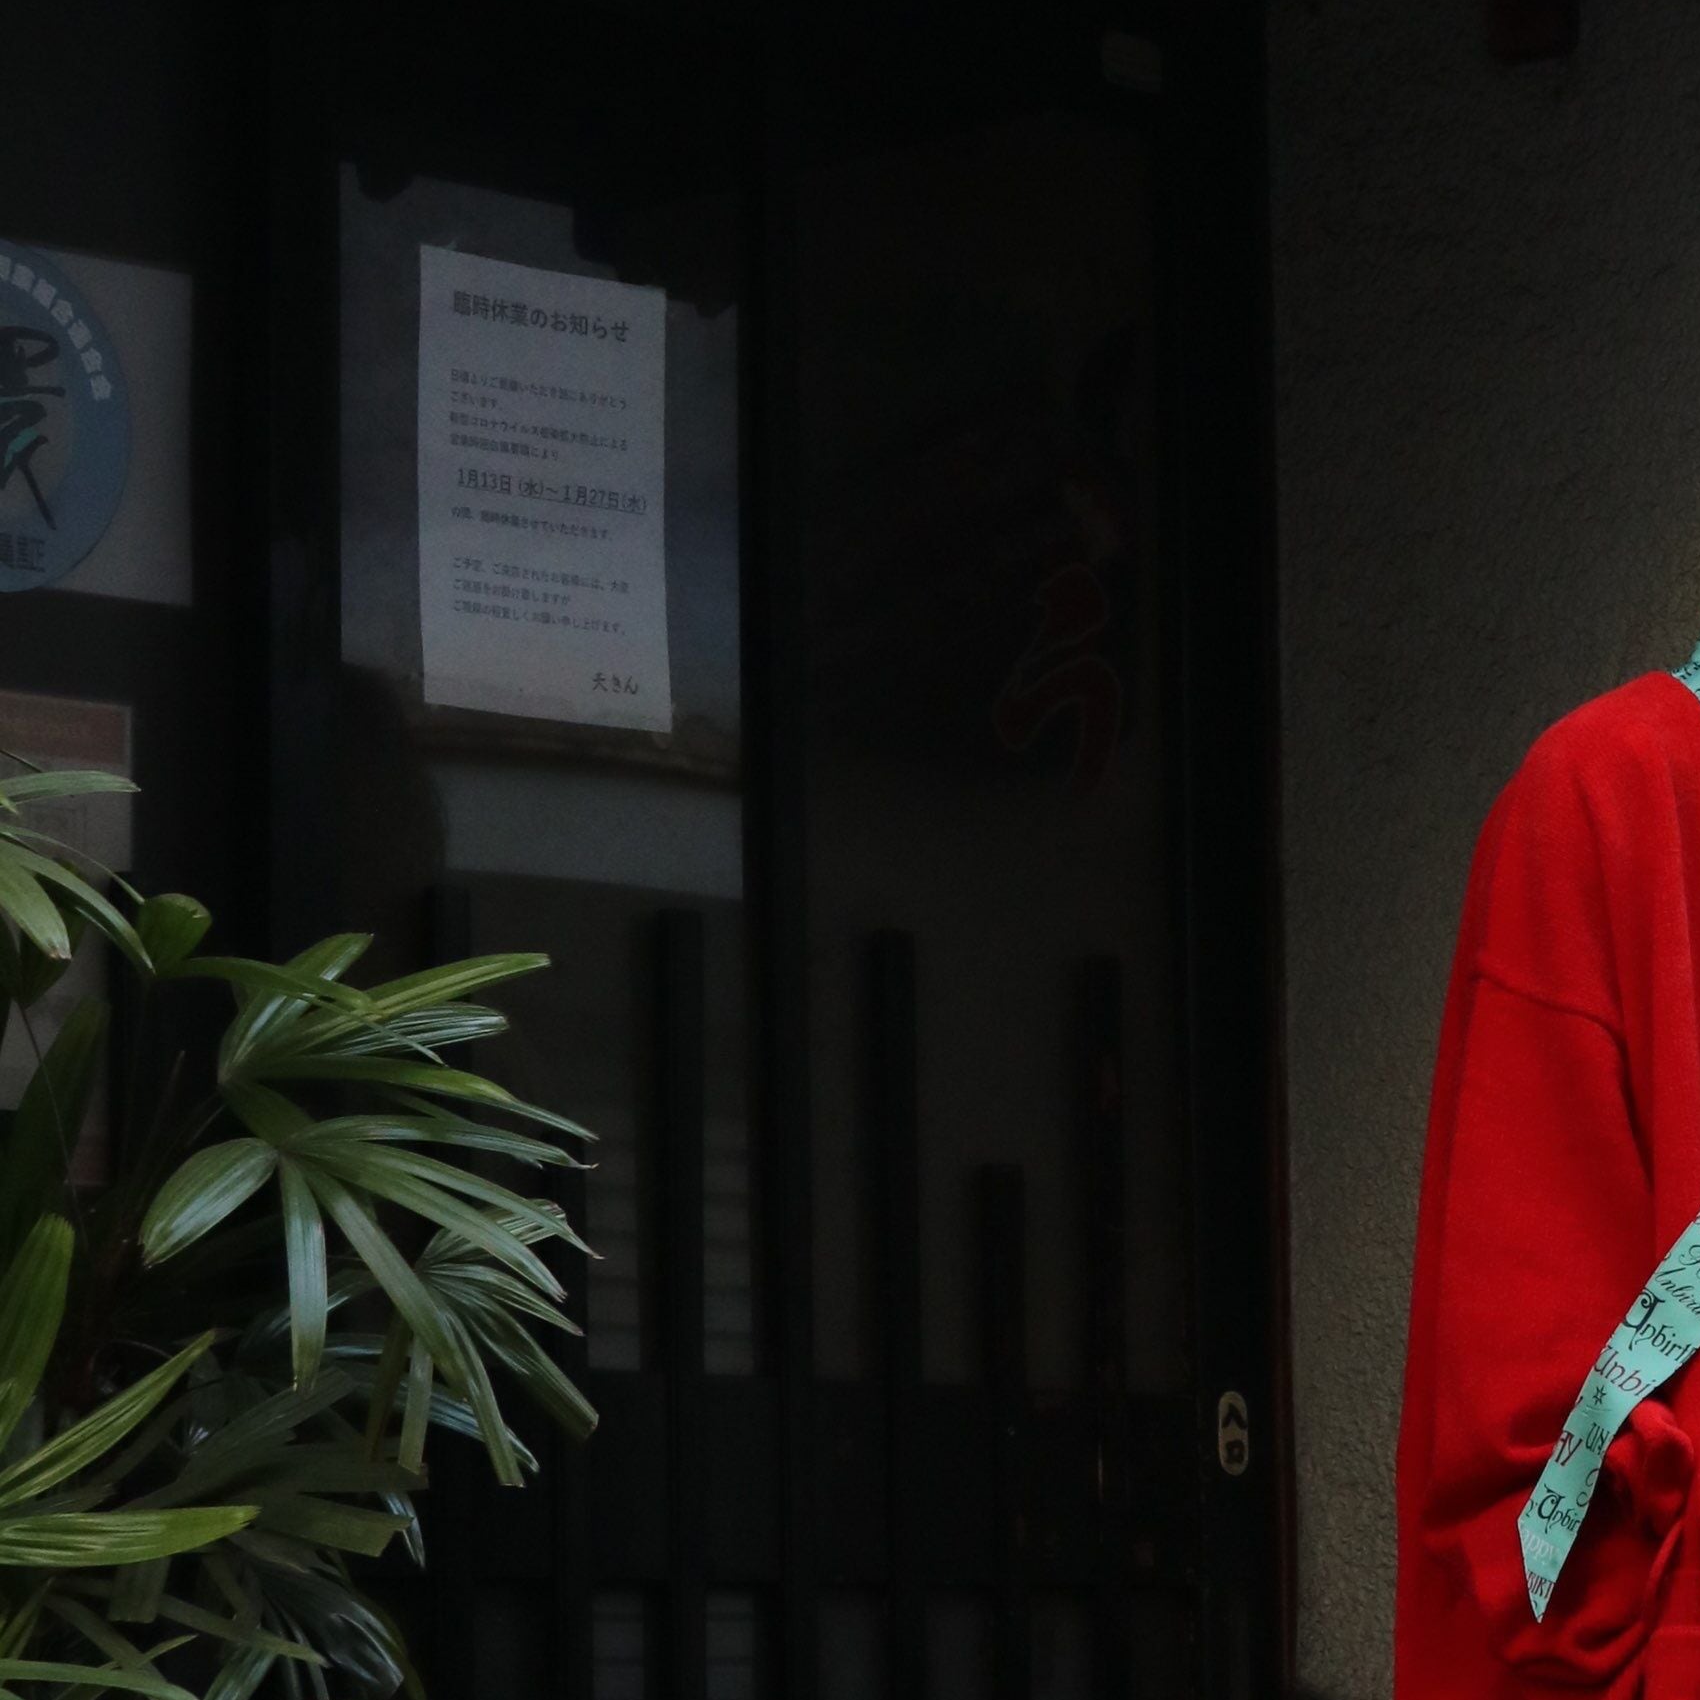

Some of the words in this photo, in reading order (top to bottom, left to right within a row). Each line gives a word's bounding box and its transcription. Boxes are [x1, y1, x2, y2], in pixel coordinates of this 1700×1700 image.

[453, 290, 630, 343] 臨時休業のお知らせ
